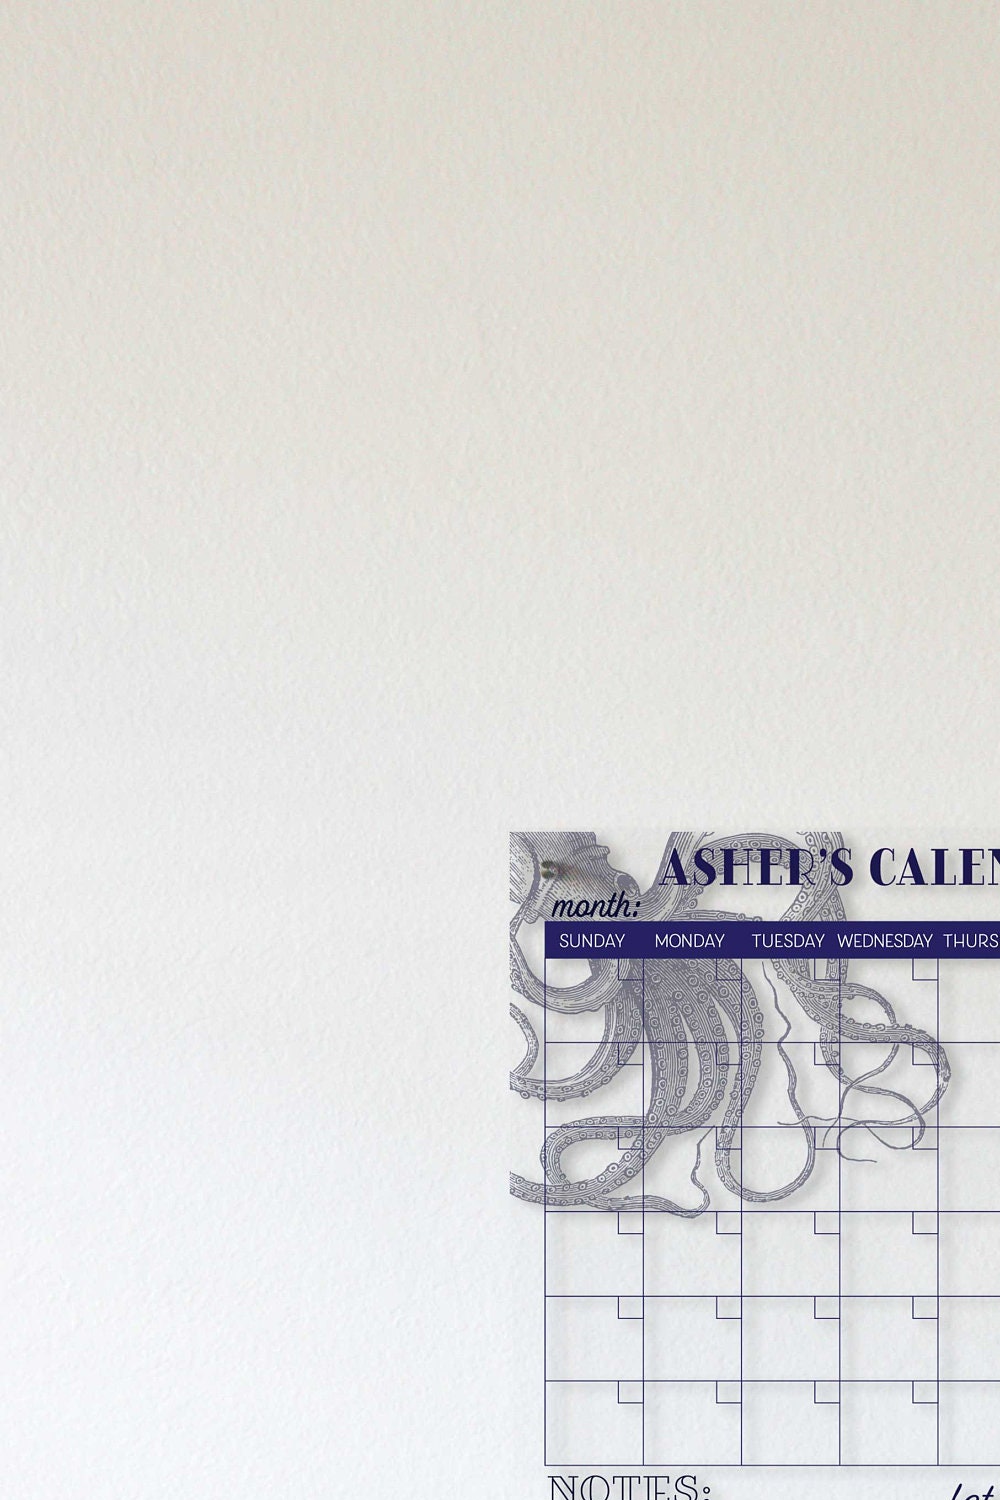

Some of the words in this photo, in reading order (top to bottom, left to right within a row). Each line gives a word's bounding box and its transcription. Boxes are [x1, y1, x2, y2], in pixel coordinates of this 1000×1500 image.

[658, 847, 854, 887] ASHER'S
[551, 892, 641, 920] month:
[559, 933, 626, 949] SUNDAY
[654, 933, 725, 949] MONDAY
[752, 933, 826, 949] TUESDAY
[837, 933, 934, 949] WEDNESDAY
